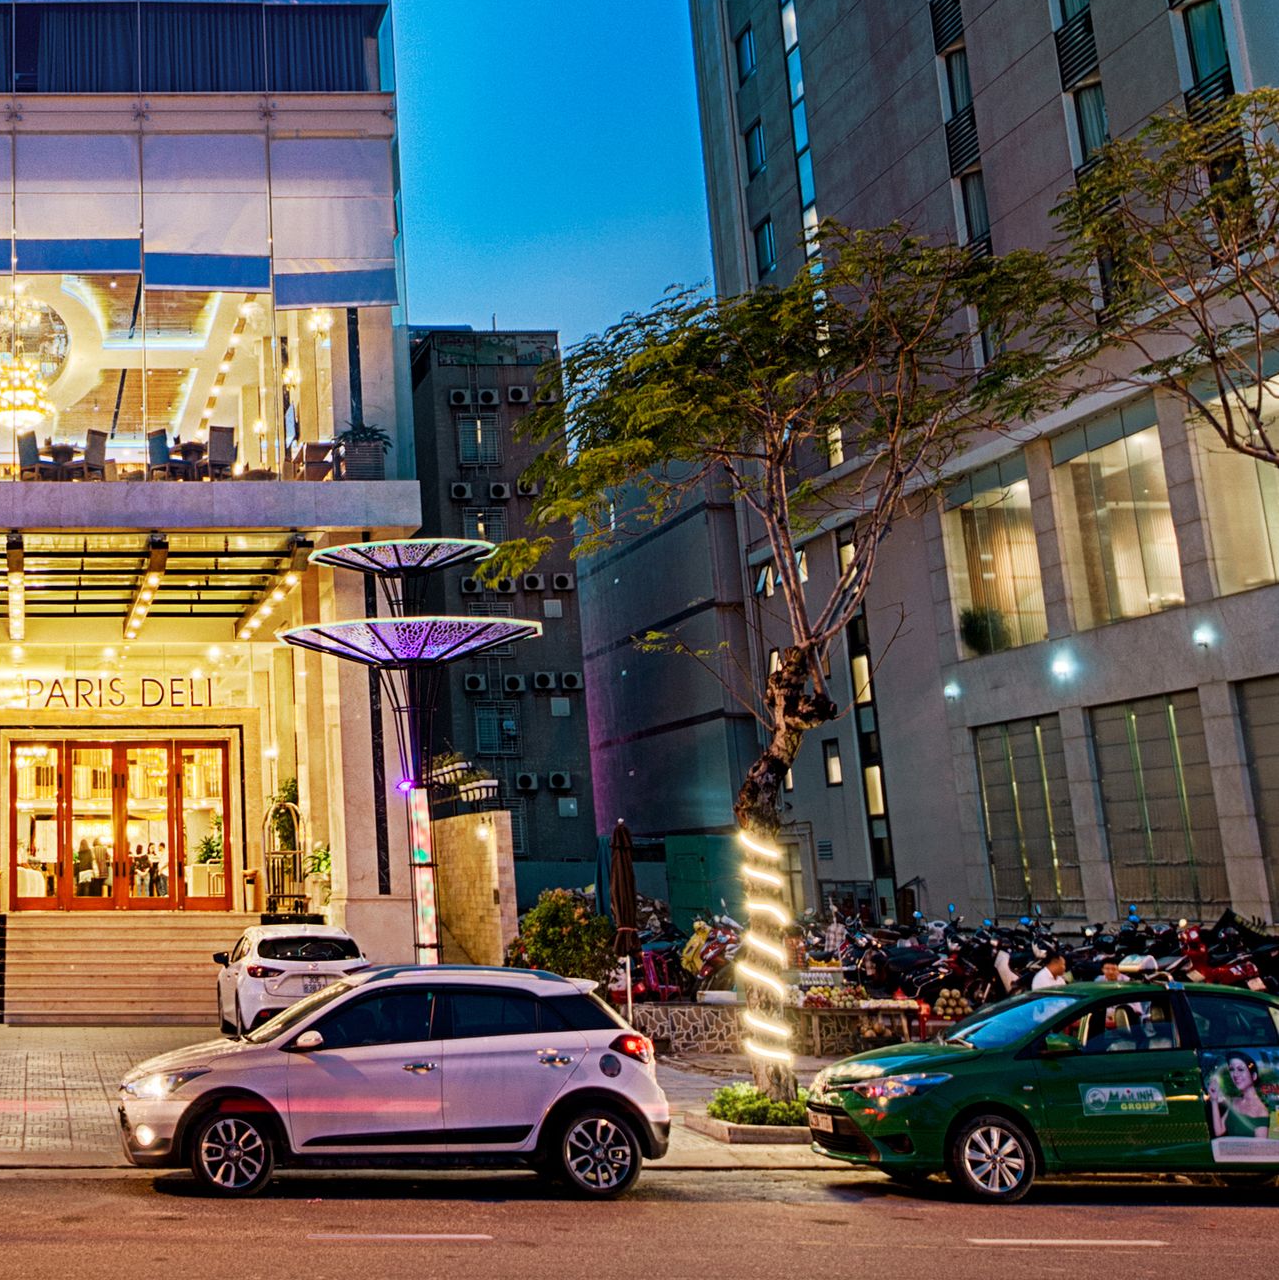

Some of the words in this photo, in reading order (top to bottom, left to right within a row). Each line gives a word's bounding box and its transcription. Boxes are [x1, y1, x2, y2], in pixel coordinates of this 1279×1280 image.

[27, 677, 126, 707] PARIS
[141, 678, 211, 707] DELI
[1120, 1102, 1156, 1111] GROUP
